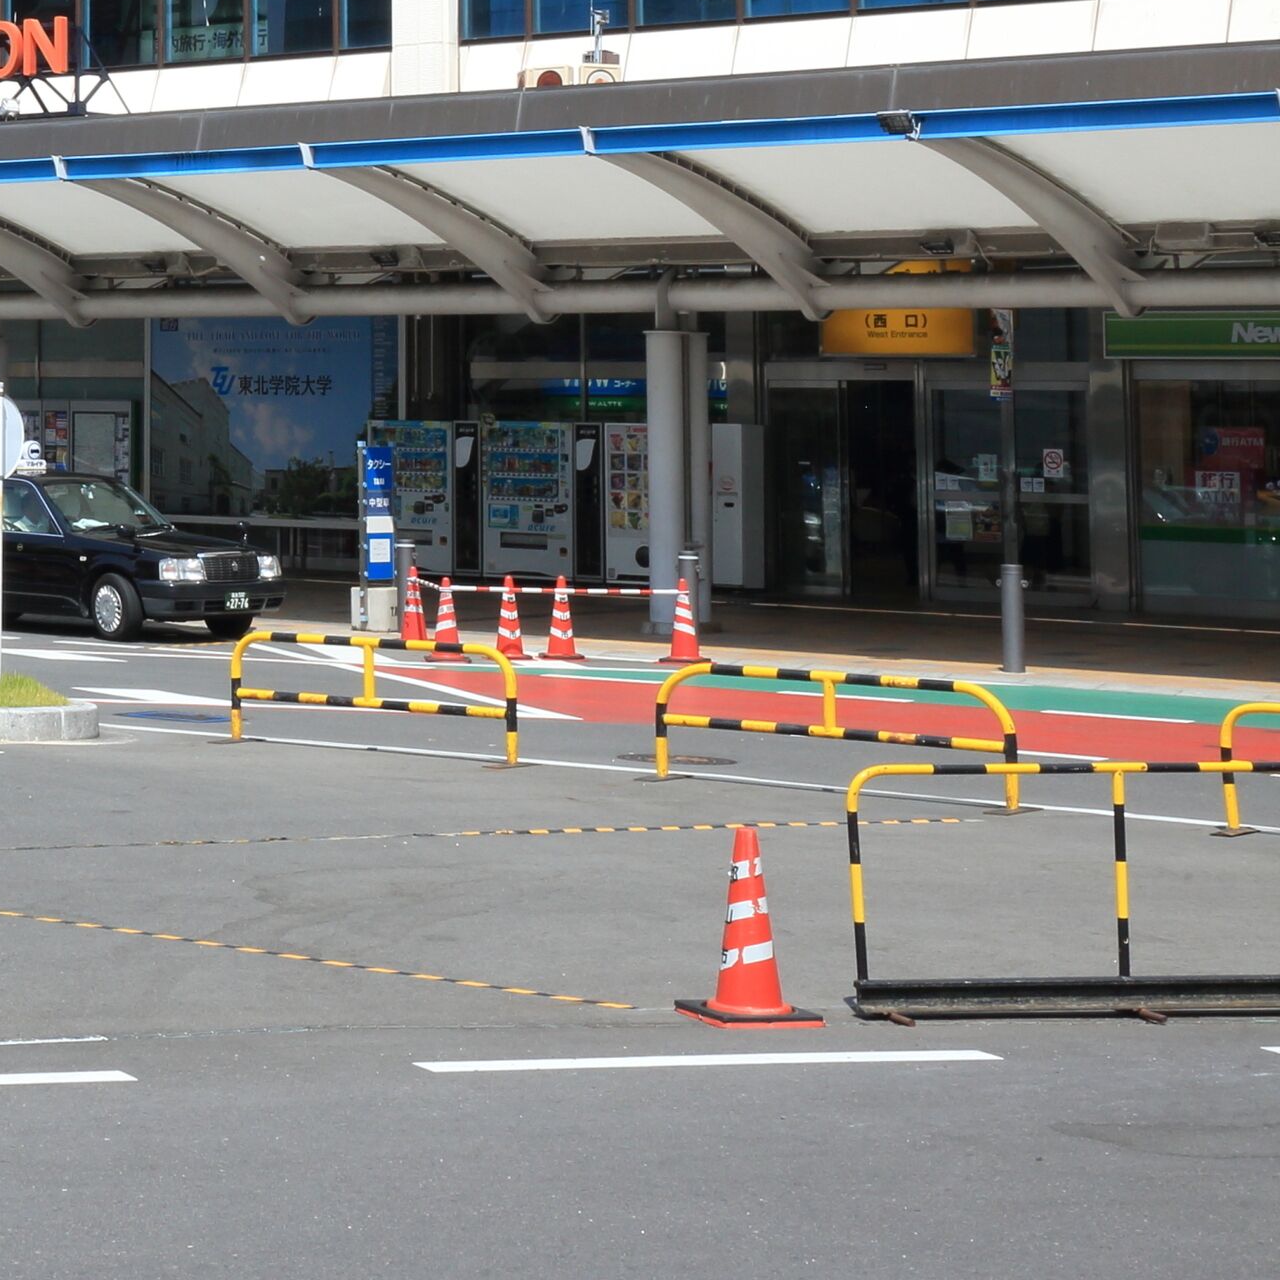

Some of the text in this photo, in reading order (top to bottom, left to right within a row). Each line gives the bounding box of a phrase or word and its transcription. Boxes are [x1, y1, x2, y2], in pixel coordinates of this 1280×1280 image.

[867, 330, 929, 338] West Entrance
[238, 375, 333, 396] 東北学院大学
[367, 460, 392, 470] タクシー
